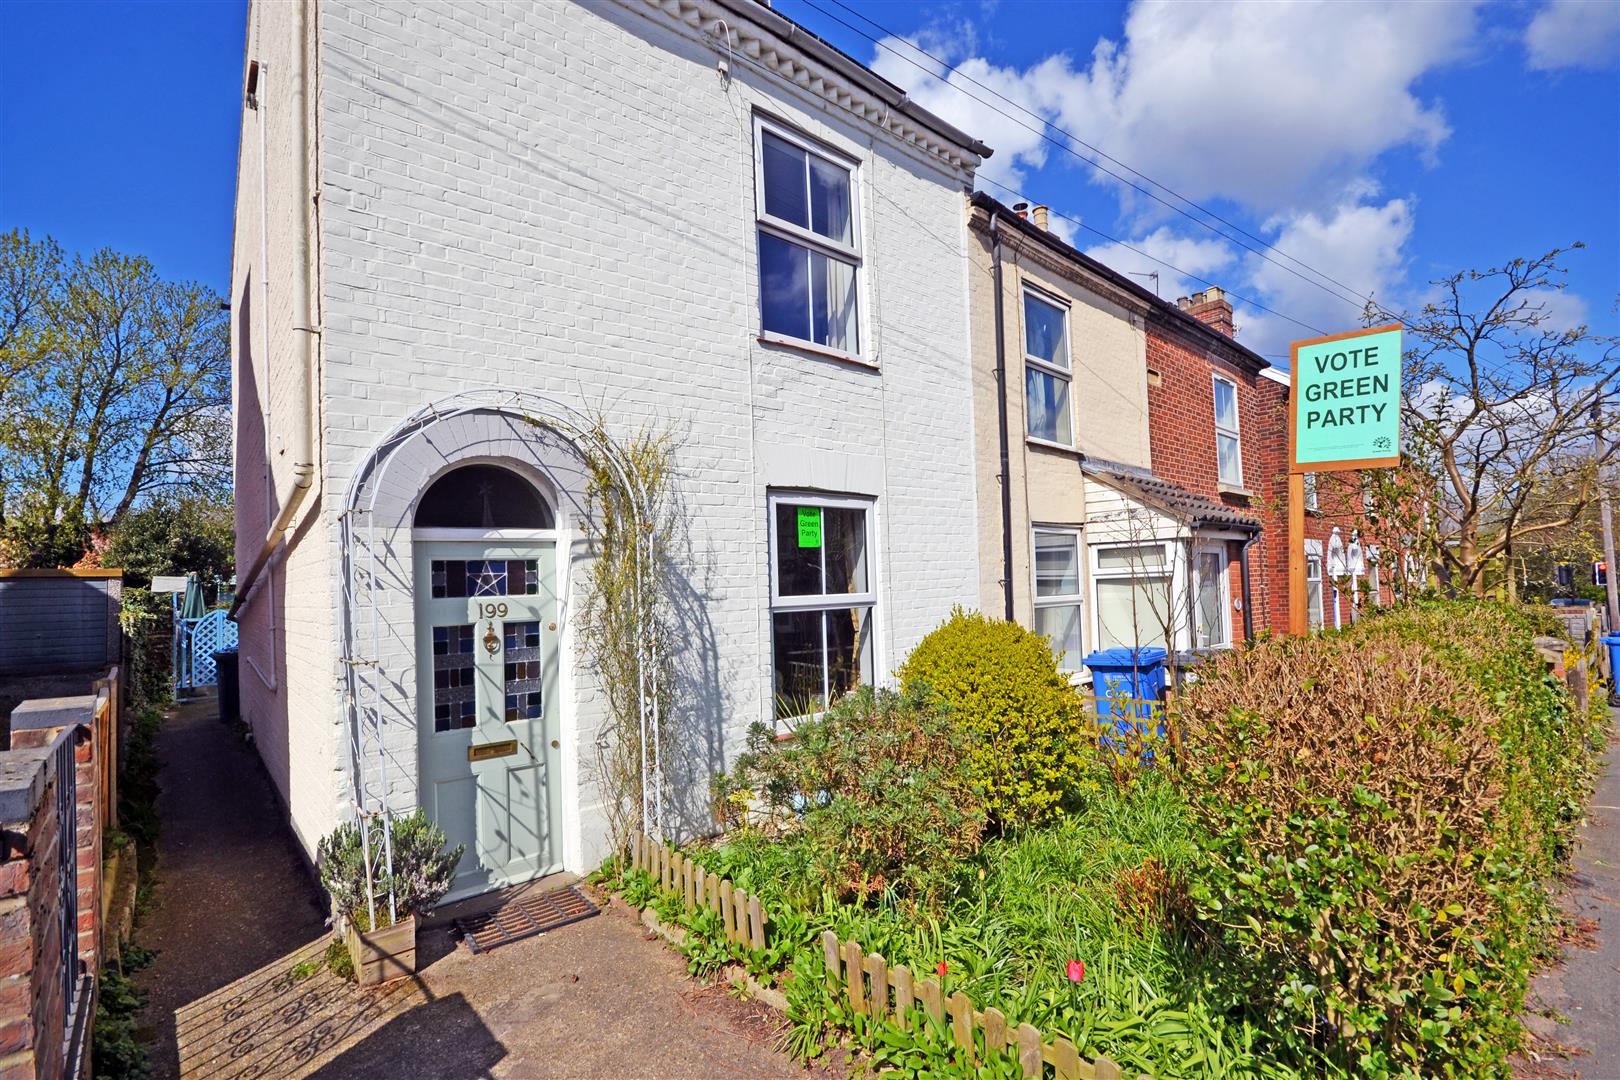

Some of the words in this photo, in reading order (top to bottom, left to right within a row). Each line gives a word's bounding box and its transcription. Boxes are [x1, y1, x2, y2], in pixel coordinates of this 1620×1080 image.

[1315, 346, 1378, 373] VOTE
[1305, 374, 1388, 402] GREEN
[1307, 402, 1387, 429] PARTY
[800, 520, 819, 528] Green
[801, 530, 818, 538] Party
[479, 602, 508, 619] 199
